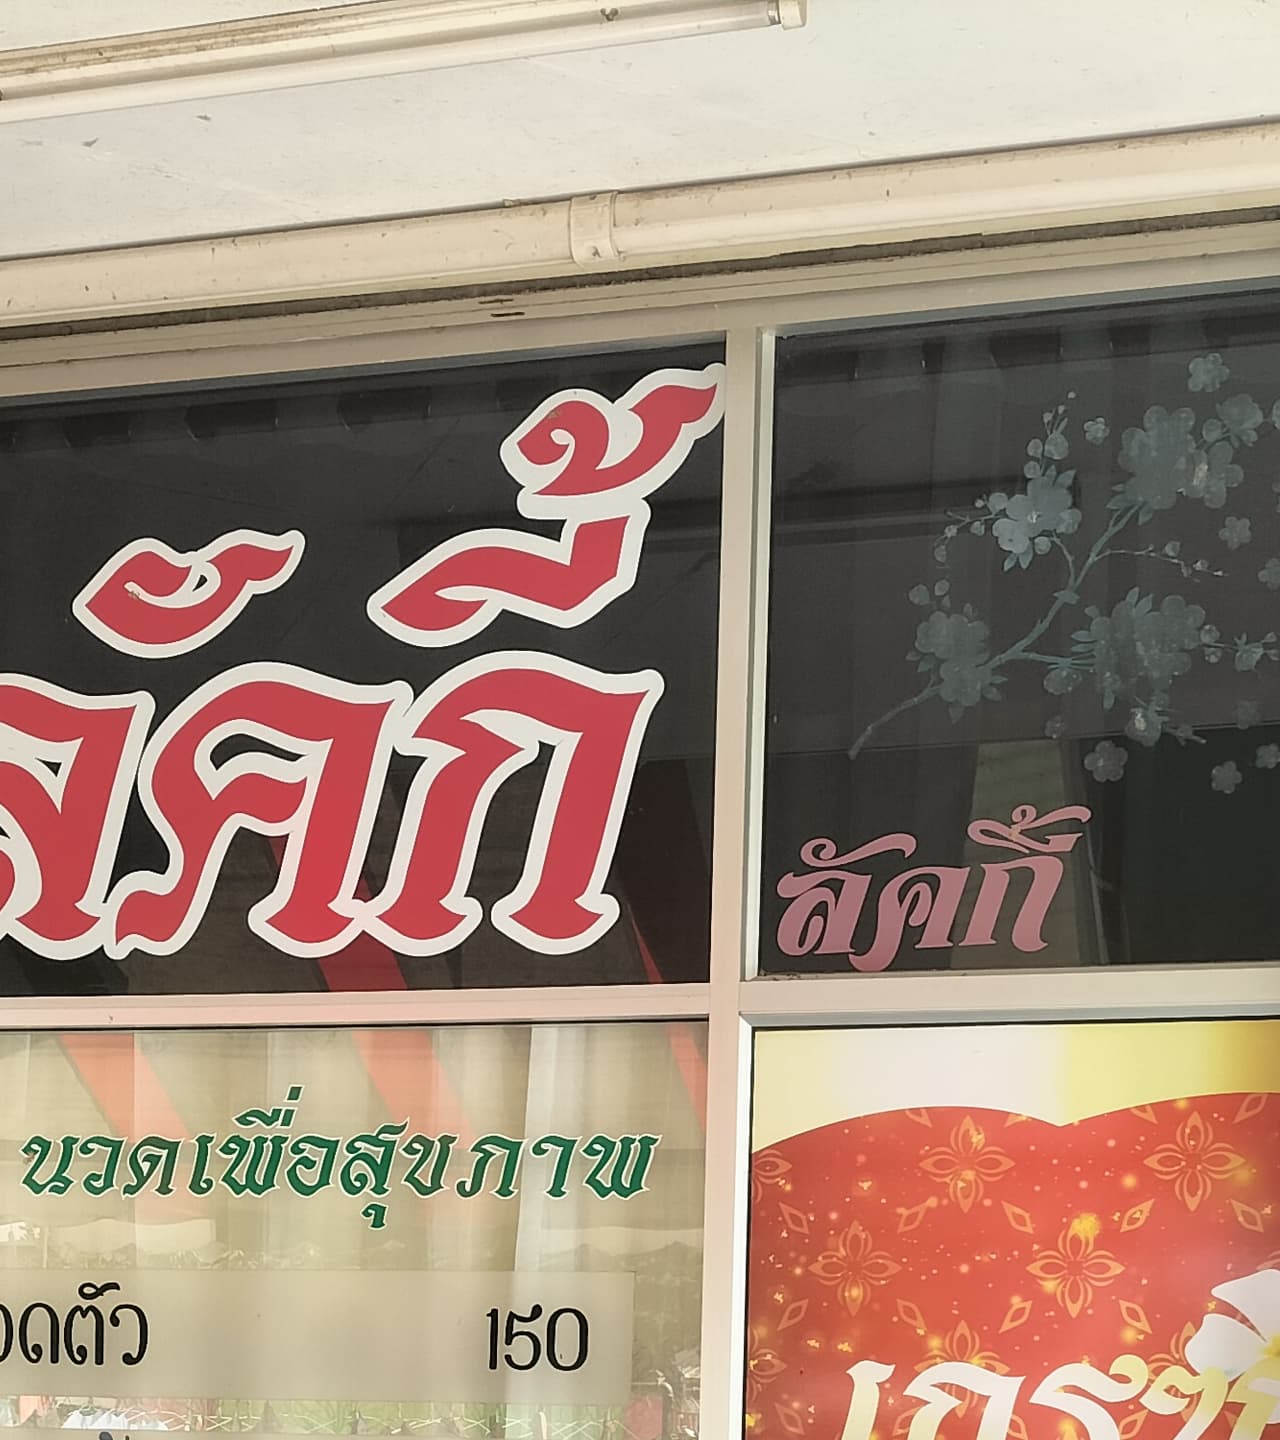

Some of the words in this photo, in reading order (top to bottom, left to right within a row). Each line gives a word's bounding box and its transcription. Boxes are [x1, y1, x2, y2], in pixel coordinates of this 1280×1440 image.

[776, 804, 1092, 972] ลัคกี้
[20, 1085, 663, 1231] นวดเพื่อสุขภาพ
[485, 1306, 590, 1373] 150
